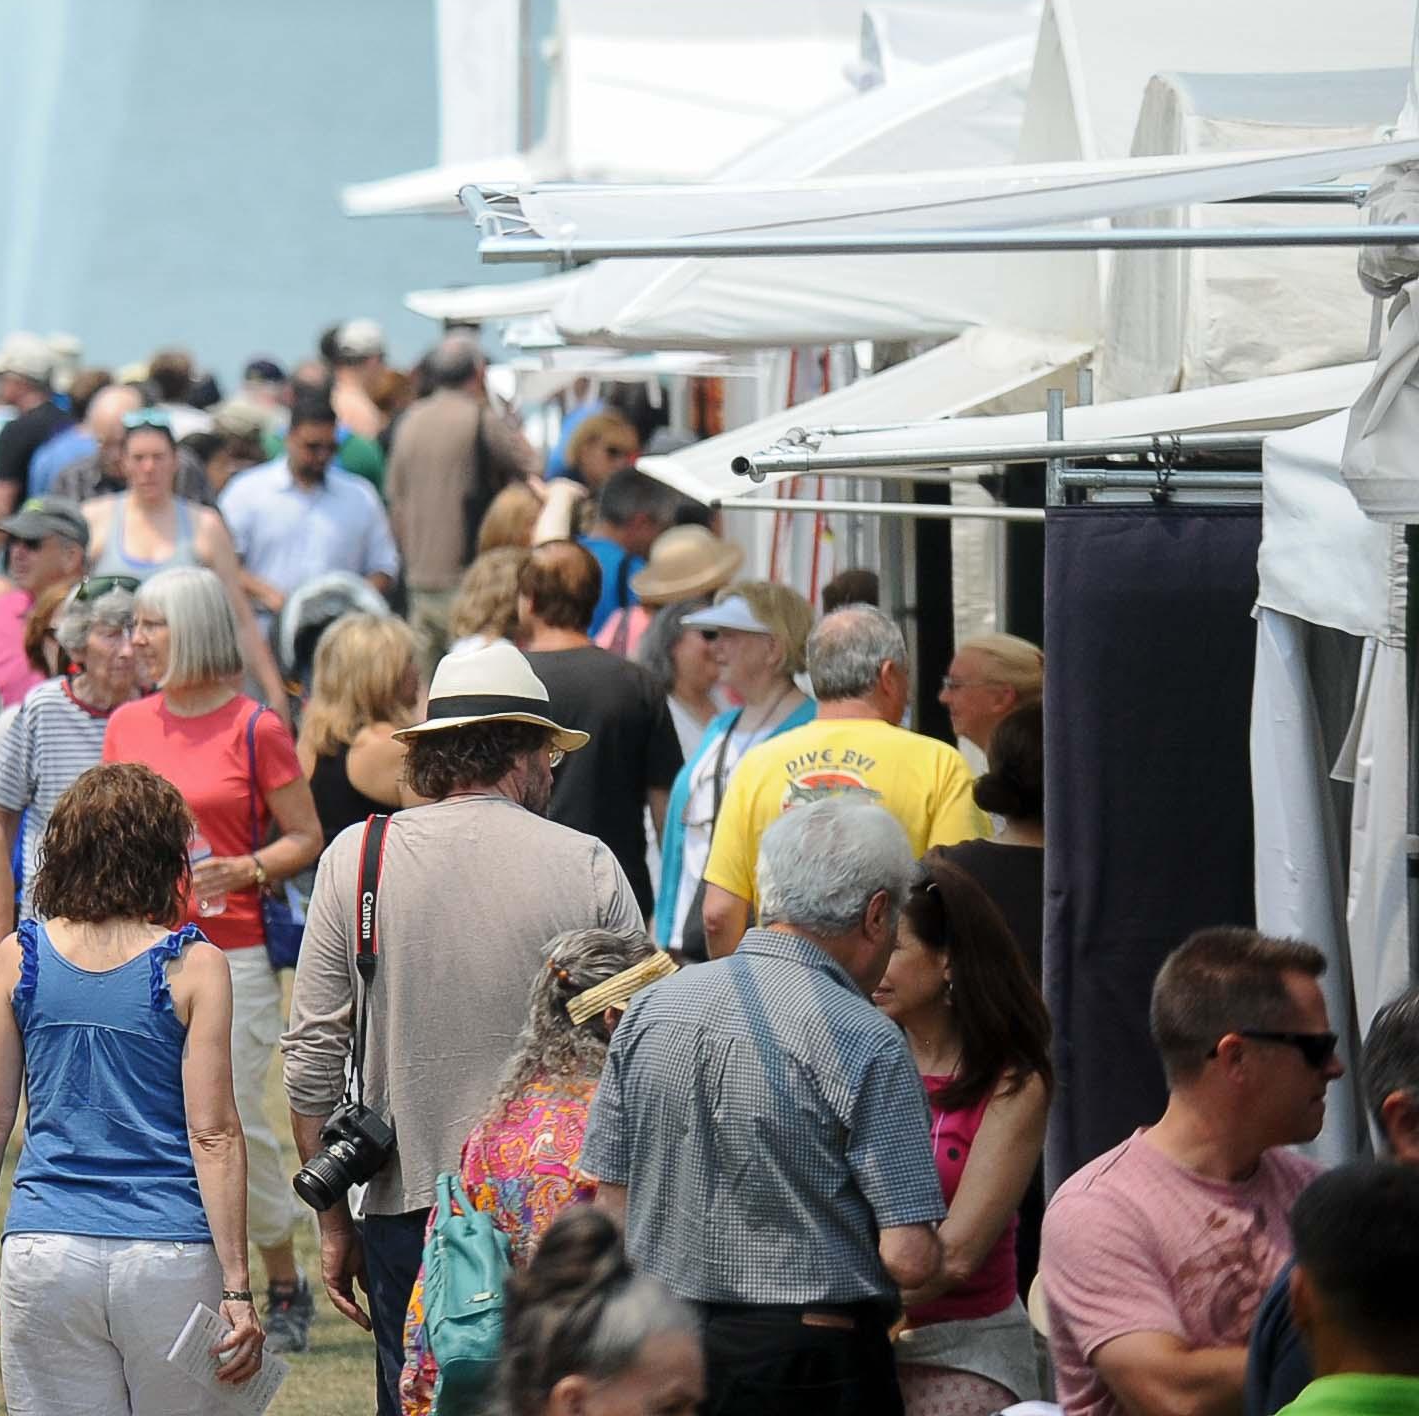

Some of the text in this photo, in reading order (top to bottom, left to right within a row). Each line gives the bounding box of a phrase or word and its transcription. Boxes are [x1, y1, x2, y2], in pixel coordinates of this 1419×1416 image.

[786, 749, 833, 773] DIVE
[842, 749, 876, 771] BVI
[362, 891, 373, 939] Canon
